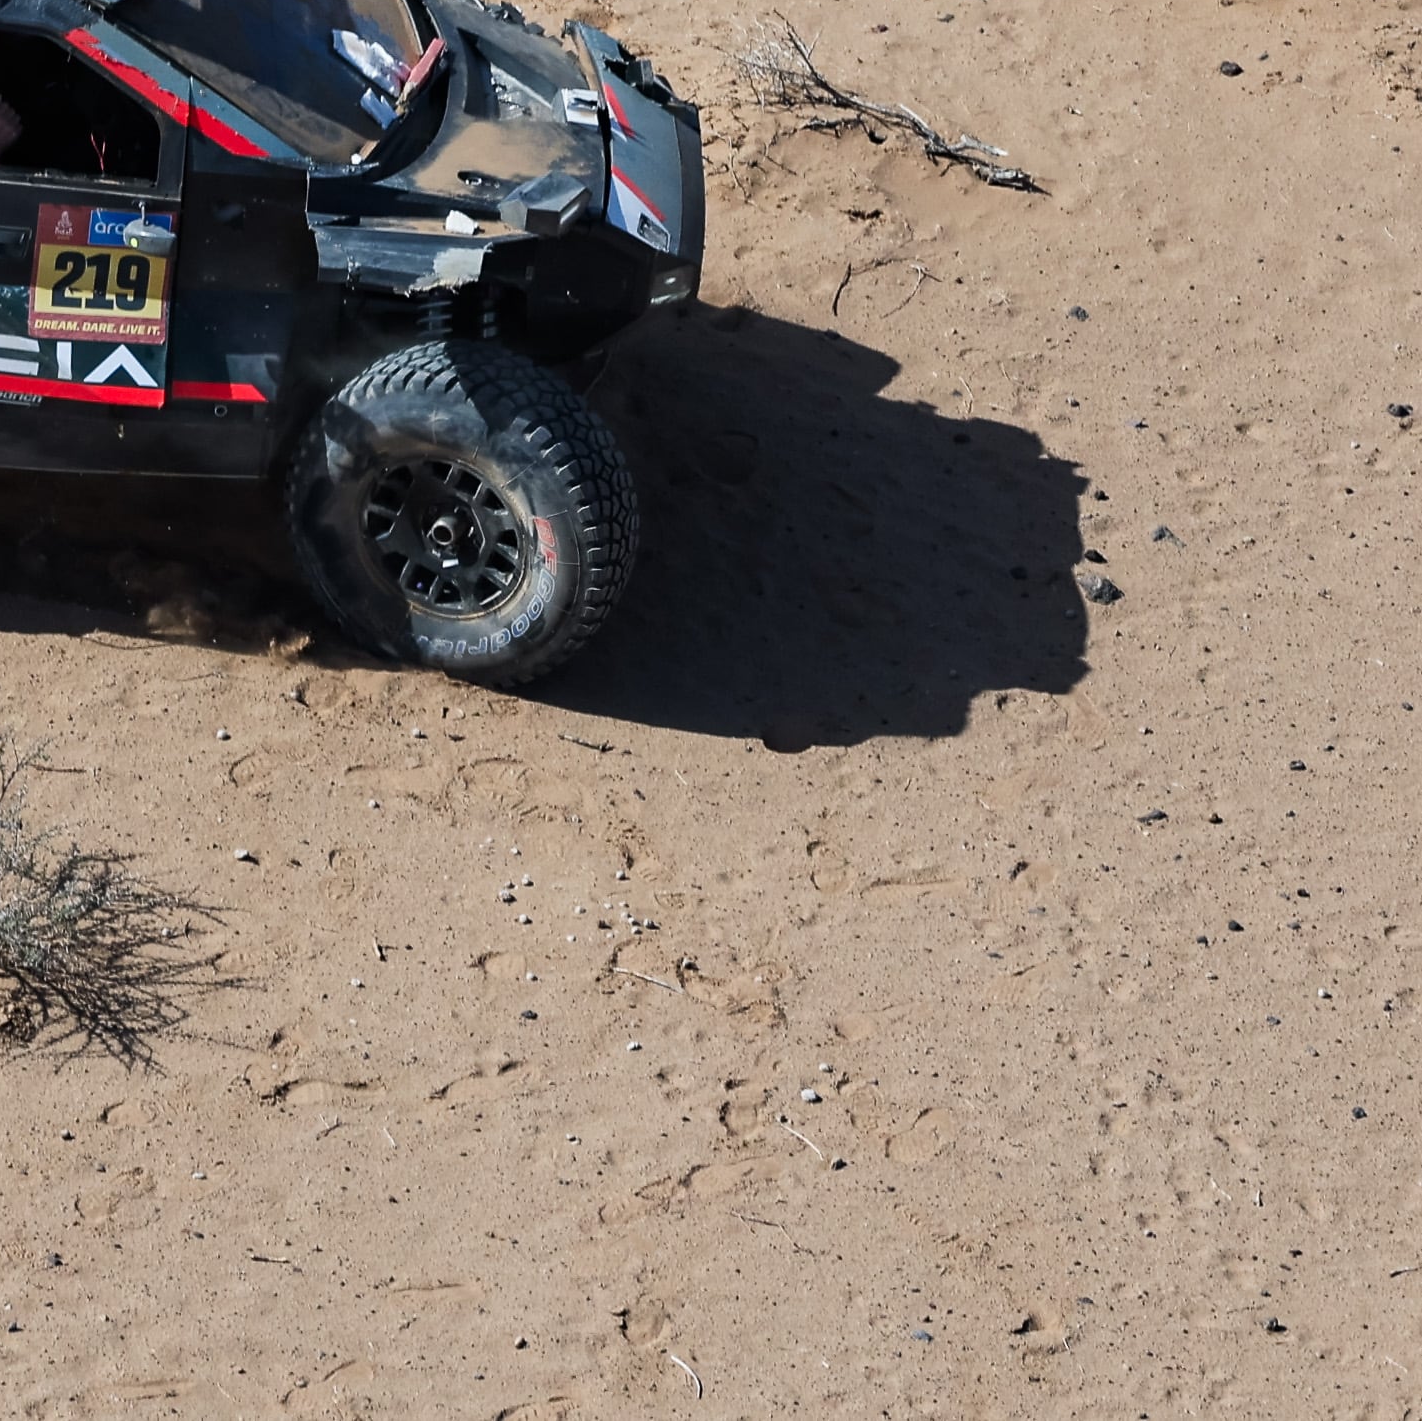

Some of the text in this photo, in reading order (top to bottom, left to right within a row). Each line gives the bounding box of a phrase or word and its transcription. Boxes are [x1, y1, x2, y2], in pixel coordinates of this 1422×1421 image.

[51, 251, 151, 311] 219
[35, 319, 161, 336] DREAM. DARE. LIVE IT.
